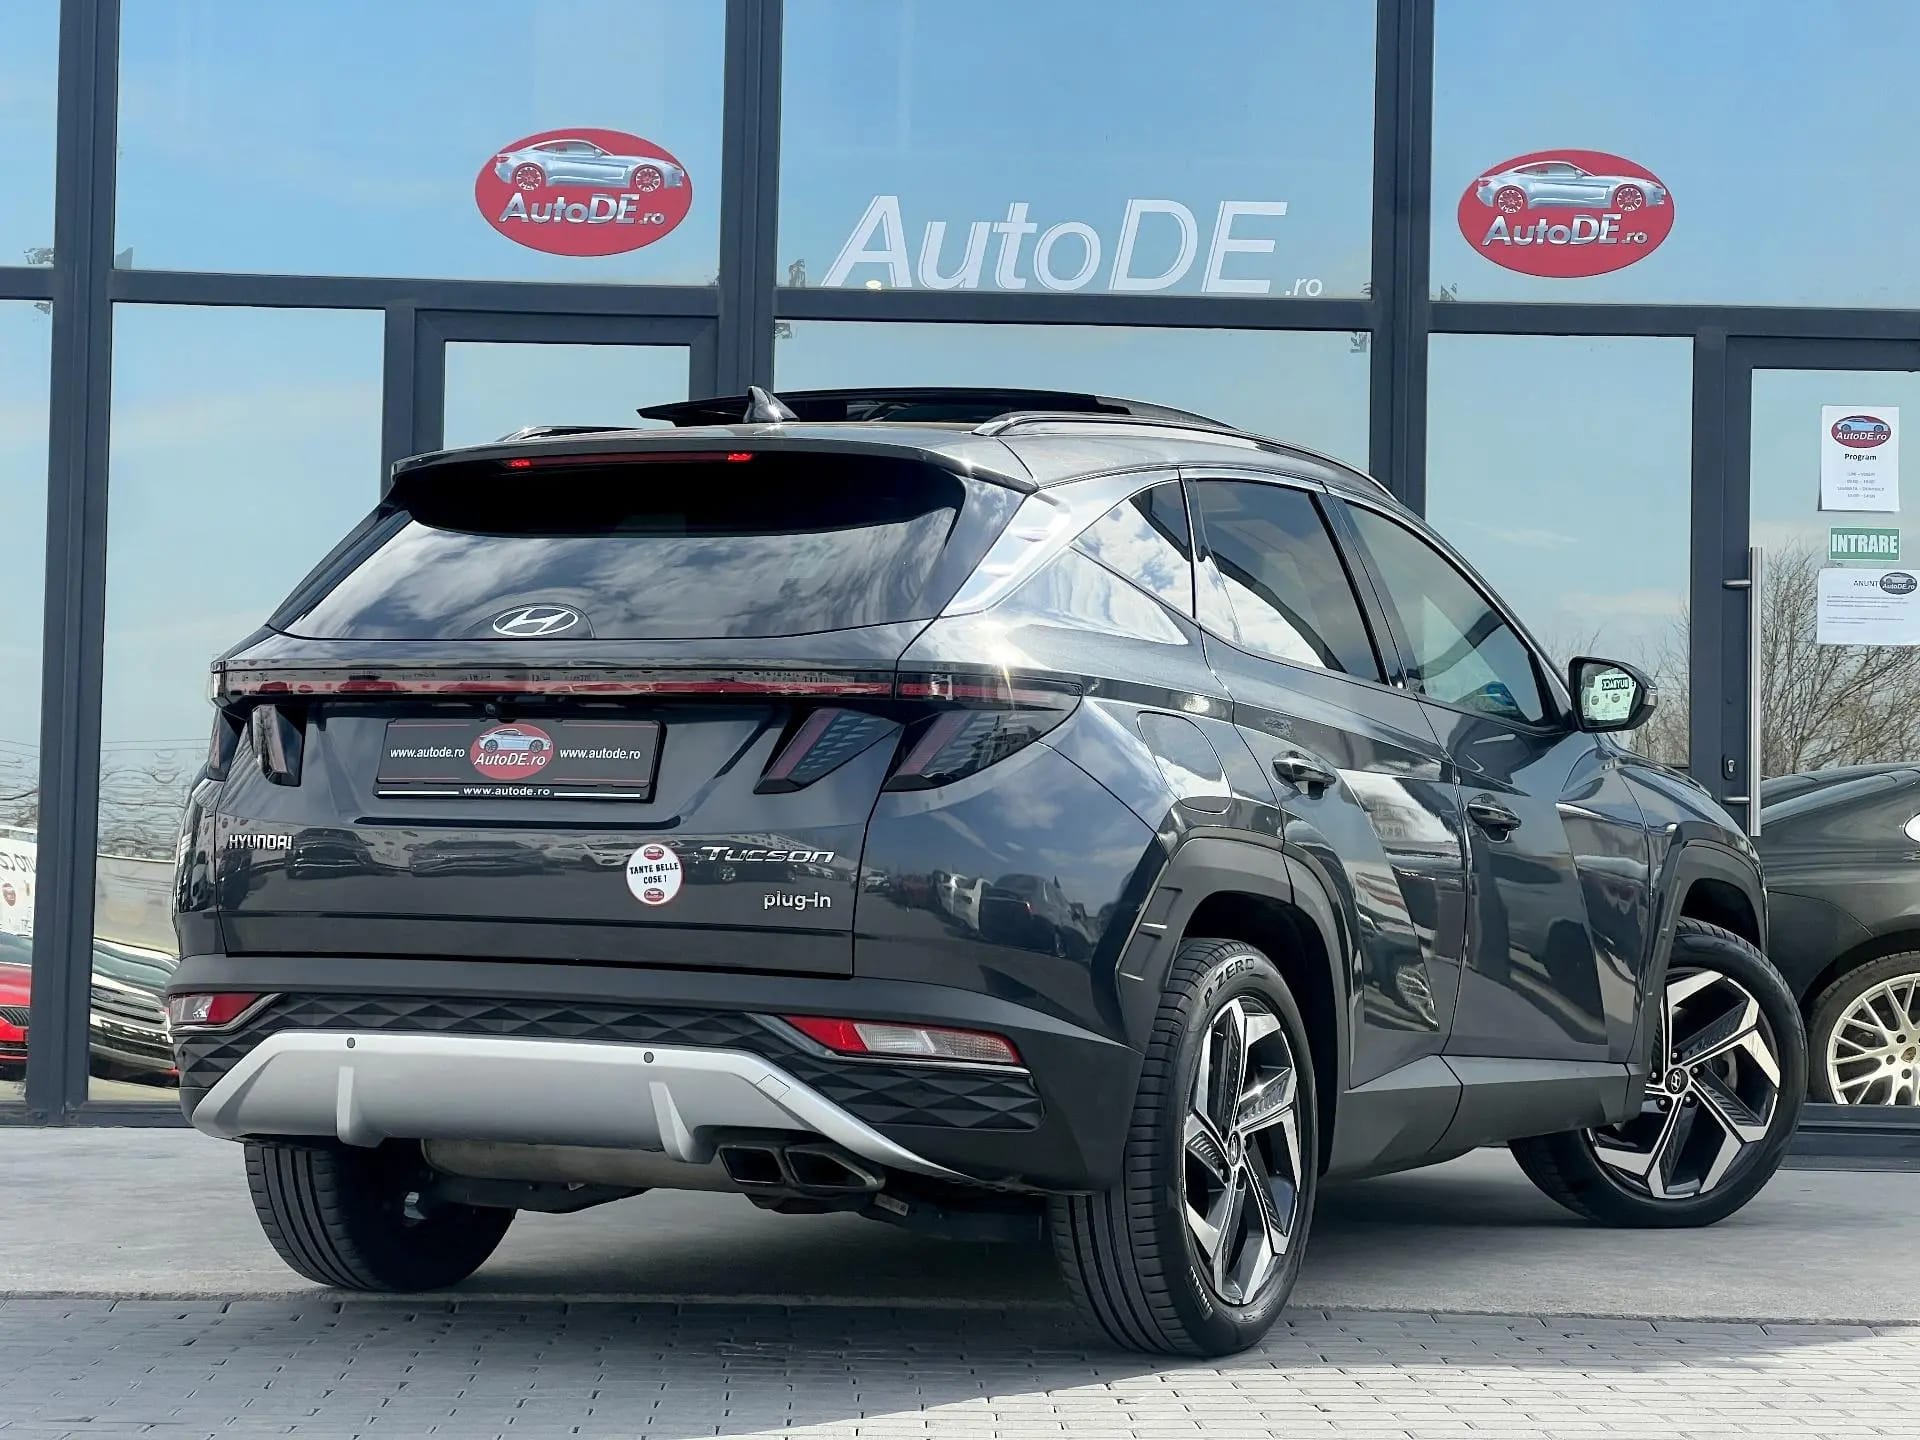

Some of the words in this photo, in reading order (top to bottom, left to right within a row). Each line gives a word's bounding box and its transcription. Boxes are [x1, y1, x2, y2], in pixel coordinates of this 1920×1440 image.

[1836, 431, 1887, 441] AutoDE.ro
[1844, 453, 1877, 462] Program
[1831, 533, 1898, 554] INTRARE
[390, 747, 465, 758] www.autode.ro
[473, 752, 546, 767] AutoDE.ro
[560, 747, 641, 760] www.autode.ro
[463, 785, 550, 796] www.autode.ro
[229, 834, 294, 850] HYUNDAI
[629, 864, 655, 876] TANTE
[656, 861, 679, 873] BELLE
[643, 875, 662, 885] COSE
[763, 890, 832, 911] plug-in
[1204, 987, 1213, 1009] P
[1215, 958, 1255, 991] ZERO
